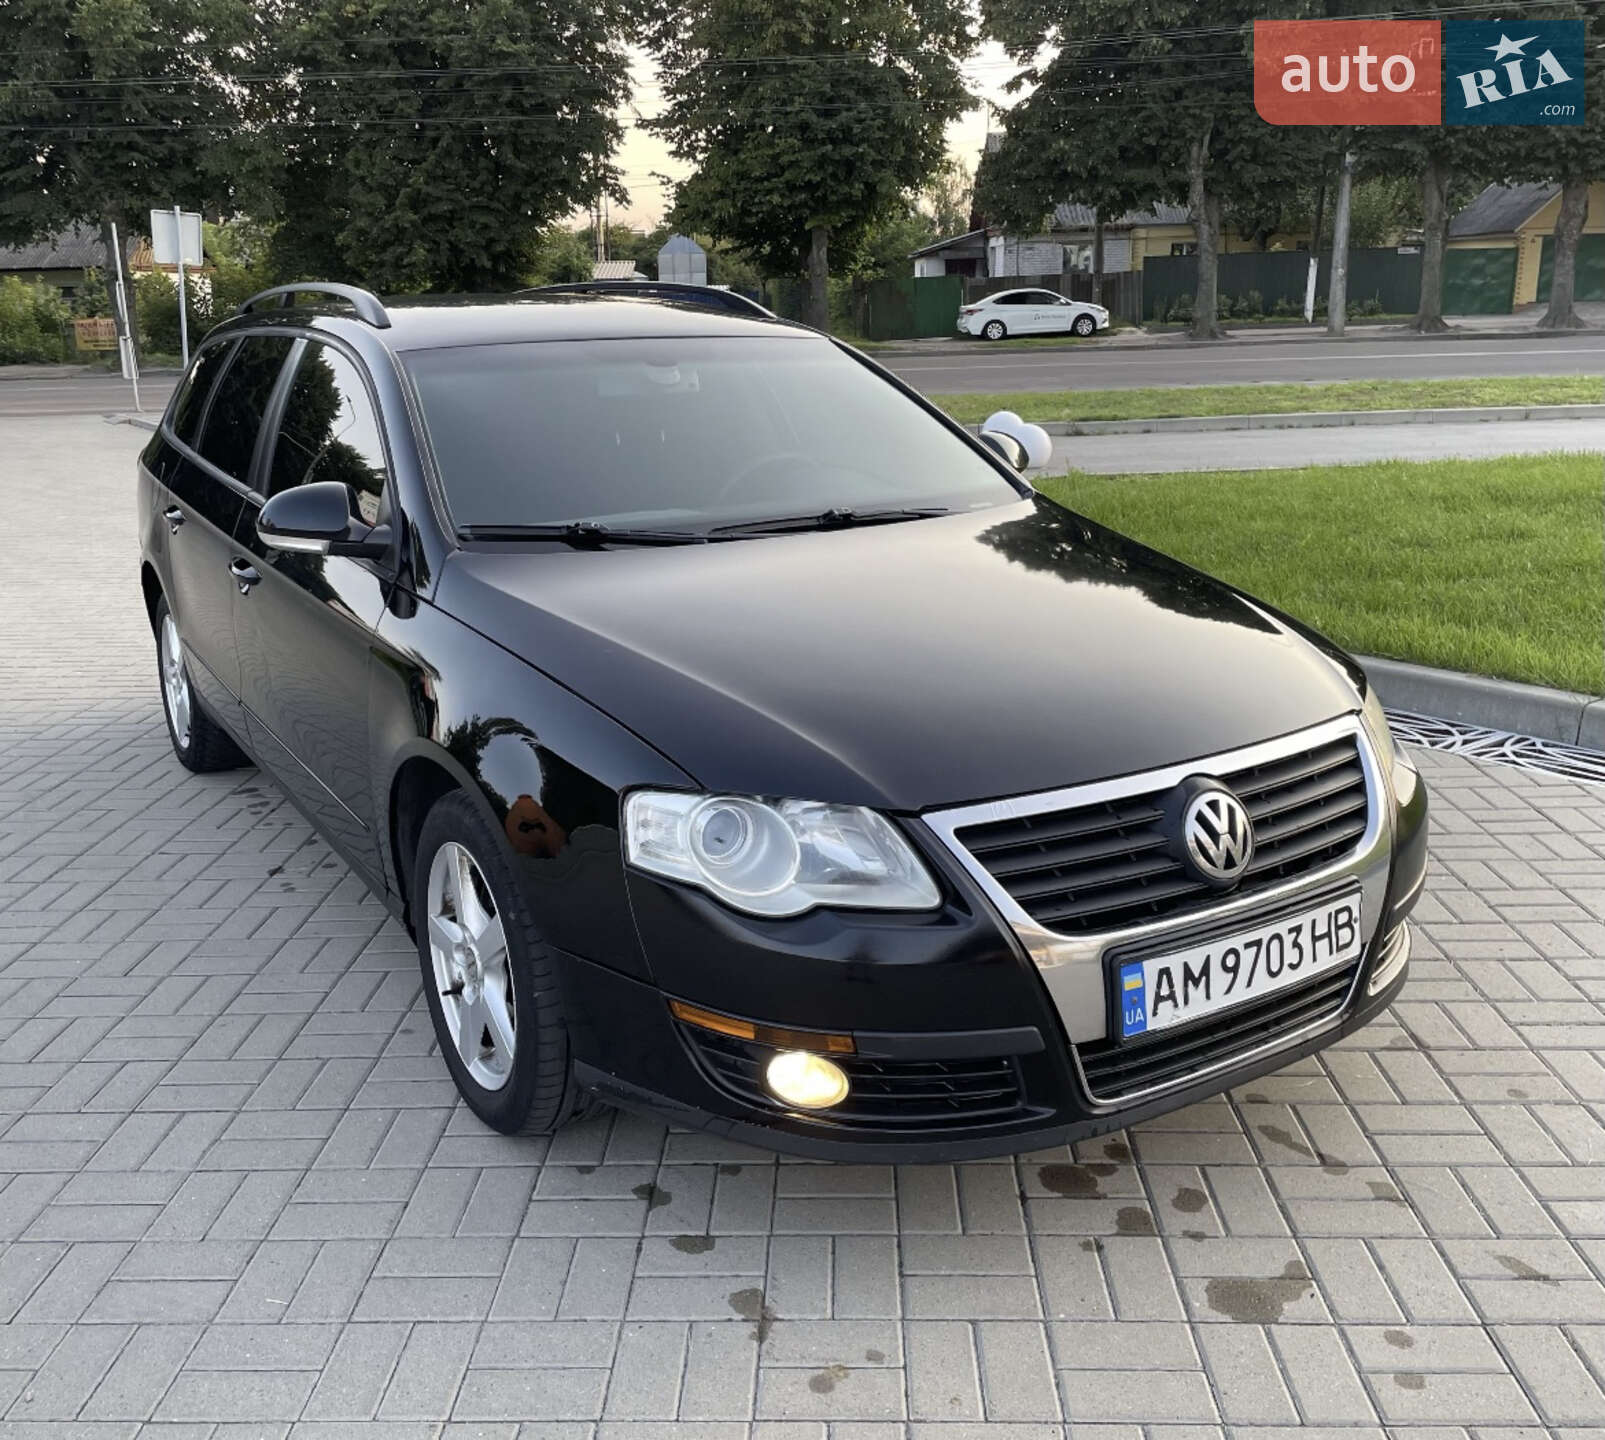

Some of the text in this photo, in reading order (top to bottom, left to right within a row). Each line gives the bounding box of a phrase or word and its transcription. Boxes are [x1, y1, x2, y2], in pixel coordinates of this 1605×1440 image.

[1152, 904, 1355, 1017] AM 9703 HB
[1125, 1007, 1145, 1025] UA
